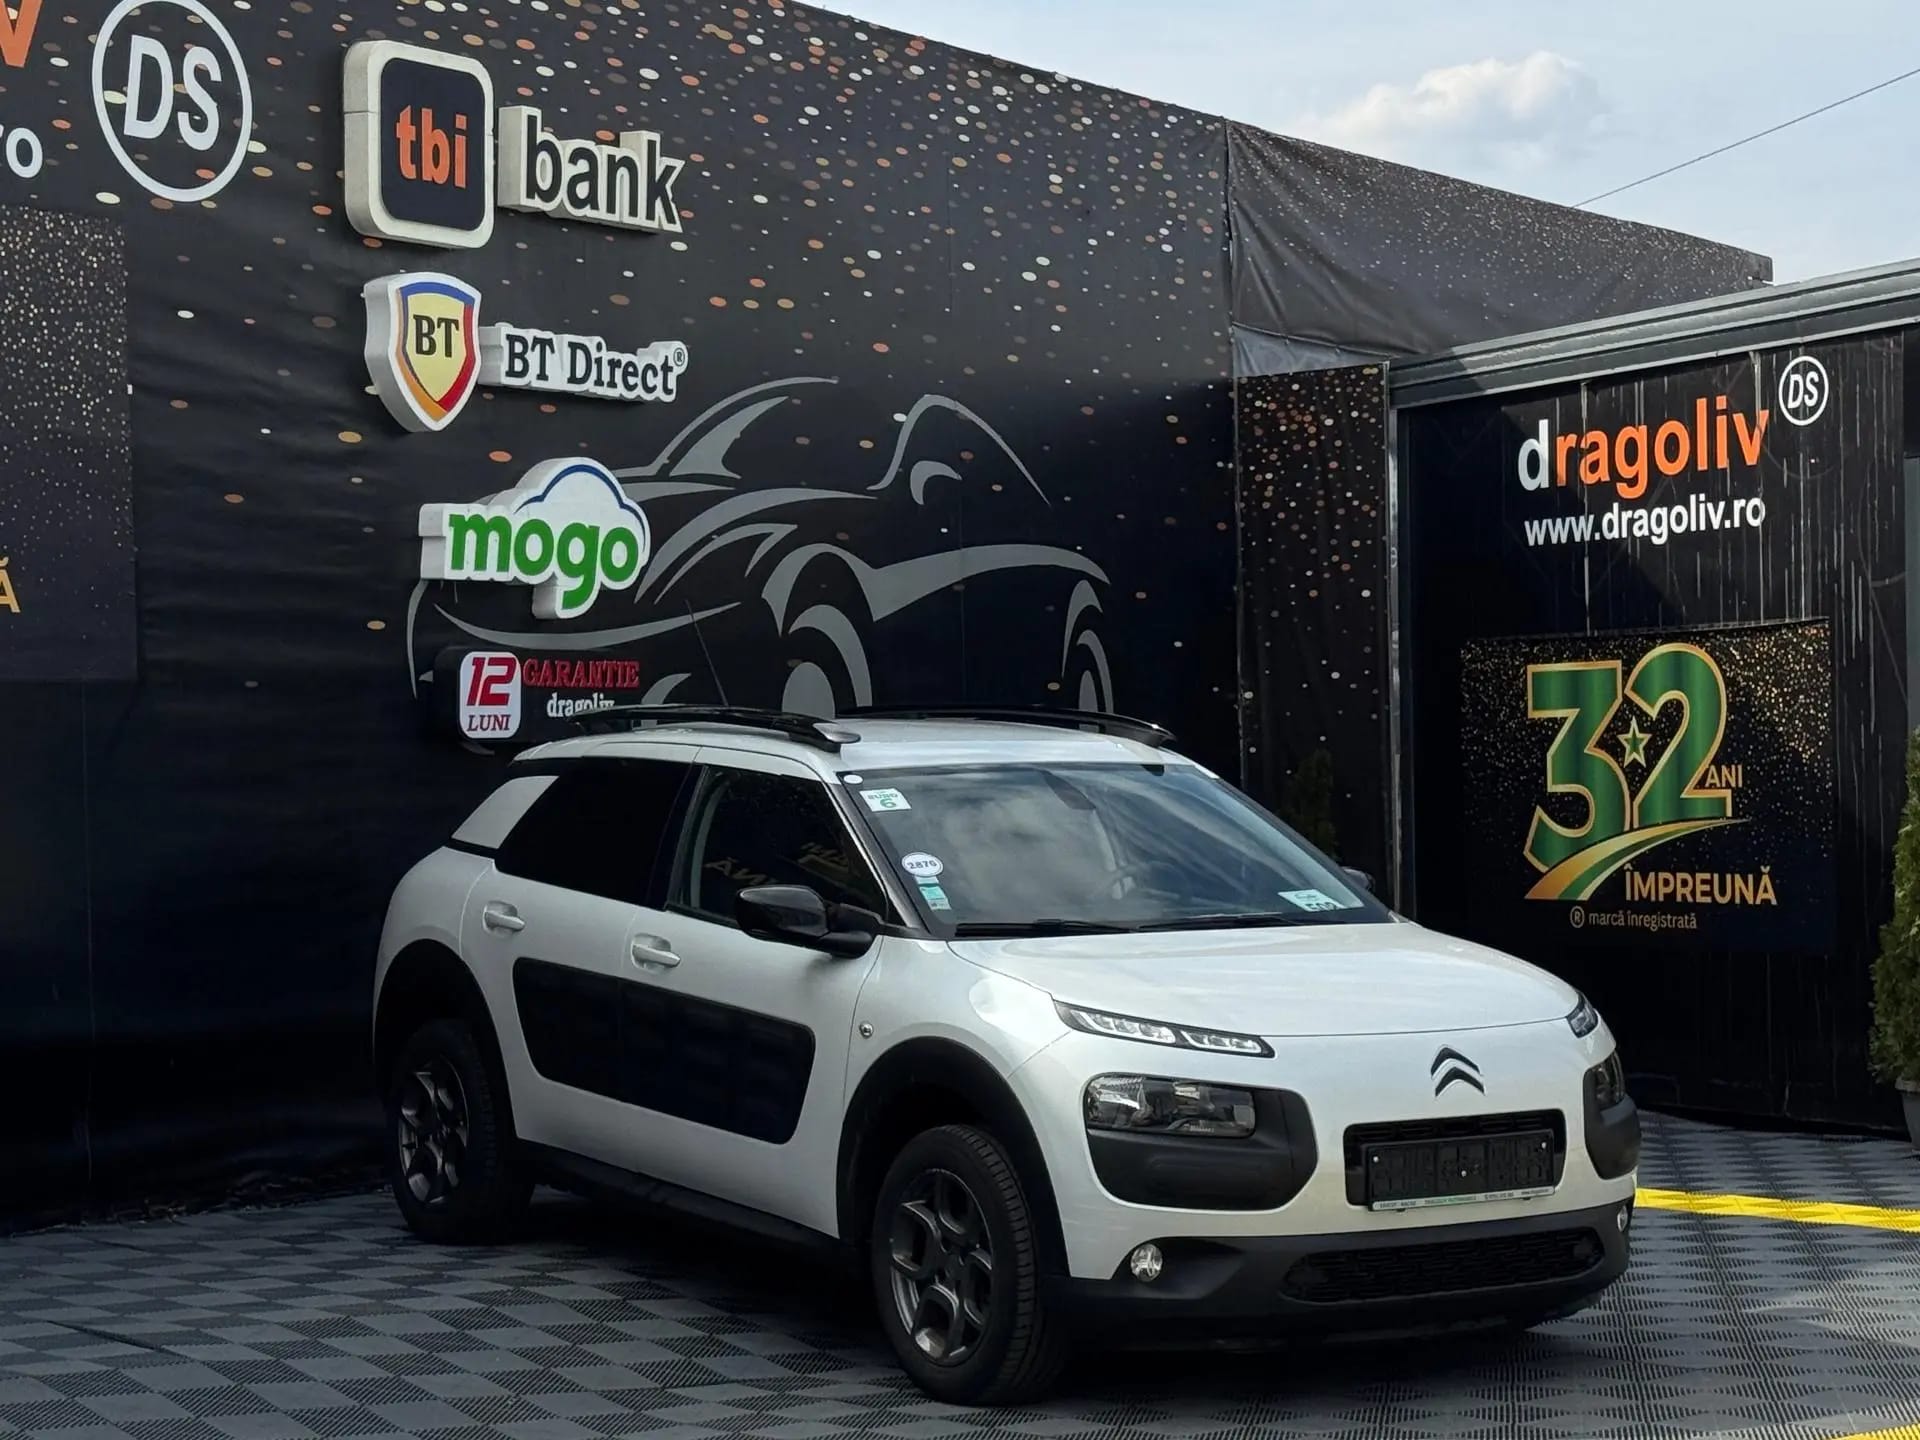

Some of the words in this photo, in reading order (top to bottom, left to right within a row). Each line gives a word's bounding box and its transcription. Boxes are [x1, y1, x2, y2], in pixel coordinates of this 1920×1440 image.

[123, 35, 222, 150] DS
[396, 107, 467, 188] tbi
[526, 115, 678, 226] bank
[413, 315, 459, 357] BT
[505, 334, 555, 381] BT
[1786, 370, 1819, 410] DS
[1518, 396, 1770, 498] dragoliv
[1525, 493, 1766, 547] www.dragoliv.ro
[448, 513, 640, 610] mogo
[466, 657, 517, 706] 12
[522, 658, 640, 688] GARANTIE
[467, 714, 511, 732] LUNI
[1523, 642, 1732, 873] 32
[1704, 763, 1743, 788] ANI
[1624, 864, 1778, 905] ÎMPREUNĂ
[1588, 909, 1625, 926] marcă
[1627, 909, 1697, 932] înregistrată
